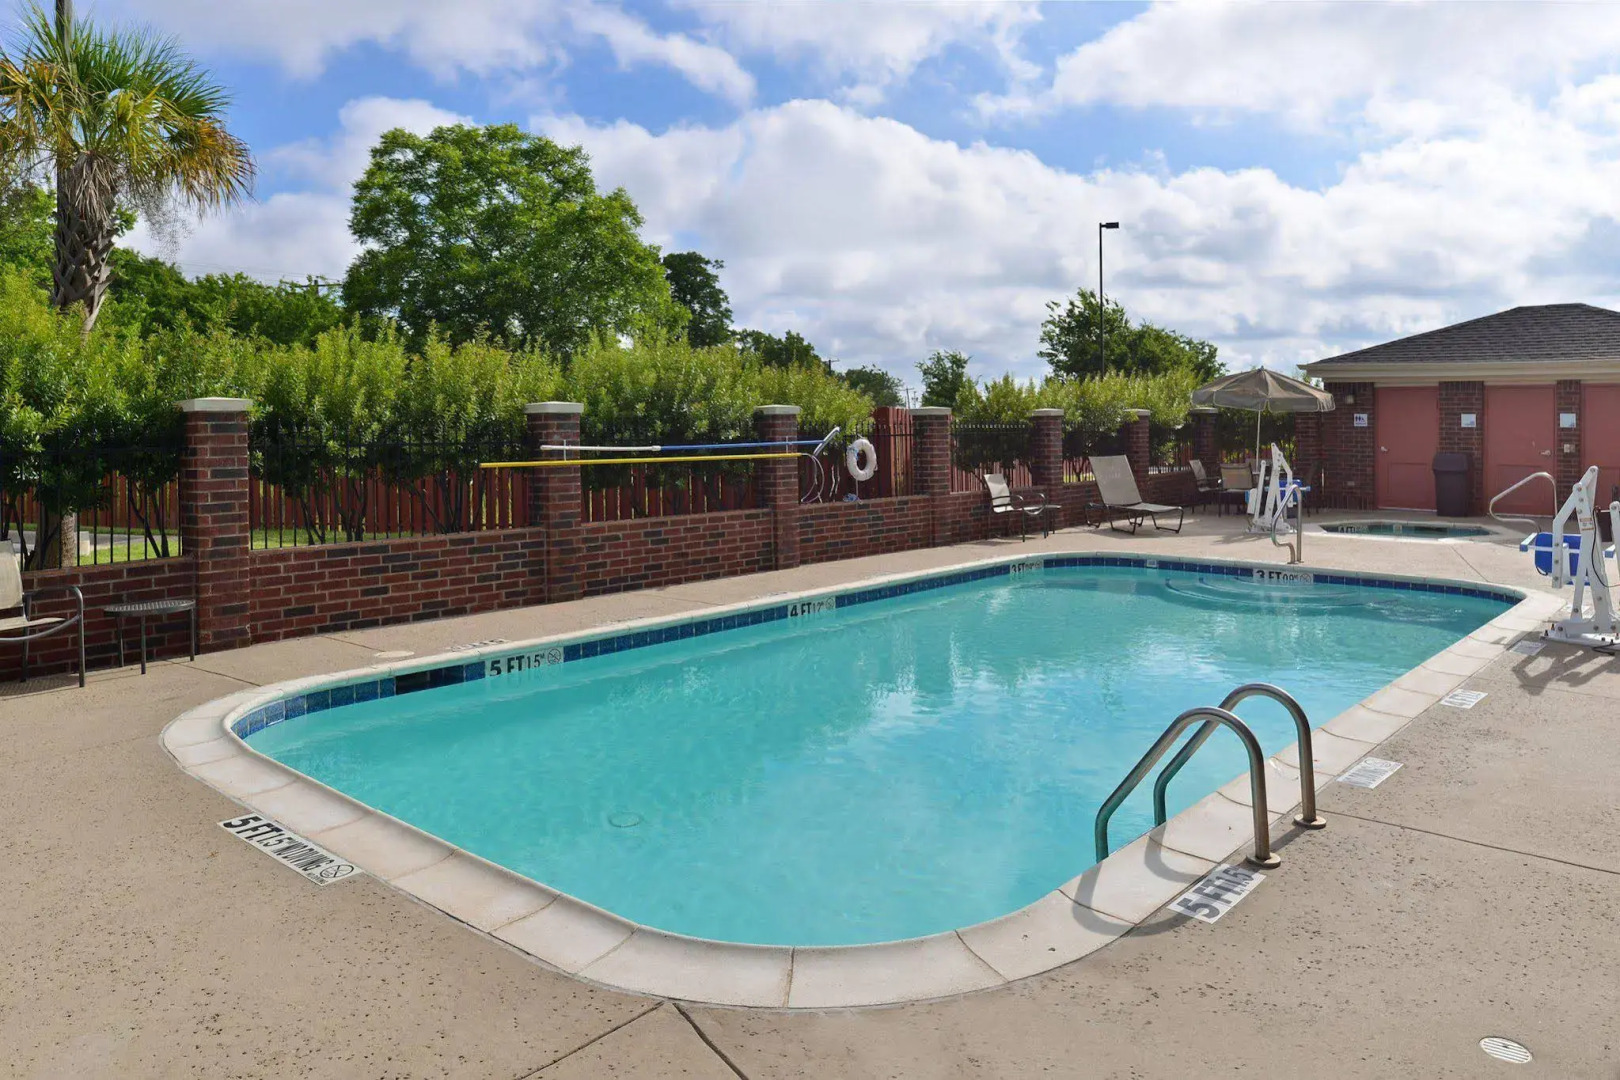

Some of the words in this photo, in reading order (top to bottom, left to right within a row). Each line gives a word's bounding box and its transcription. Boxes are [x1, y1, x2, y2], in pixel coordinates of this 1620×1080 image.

[1269, 571, 1282, 580] FT
[790, 604, 798, 617] 4
[801, 602, 811, 615] FT
[489, 660, 502, 676] 5
[507, 655, 525, 673] FT
[223, 815, 262, 829] 5
[281, 847, 335, 872] DIVING
[1176, 897, 1220, 919] 5
